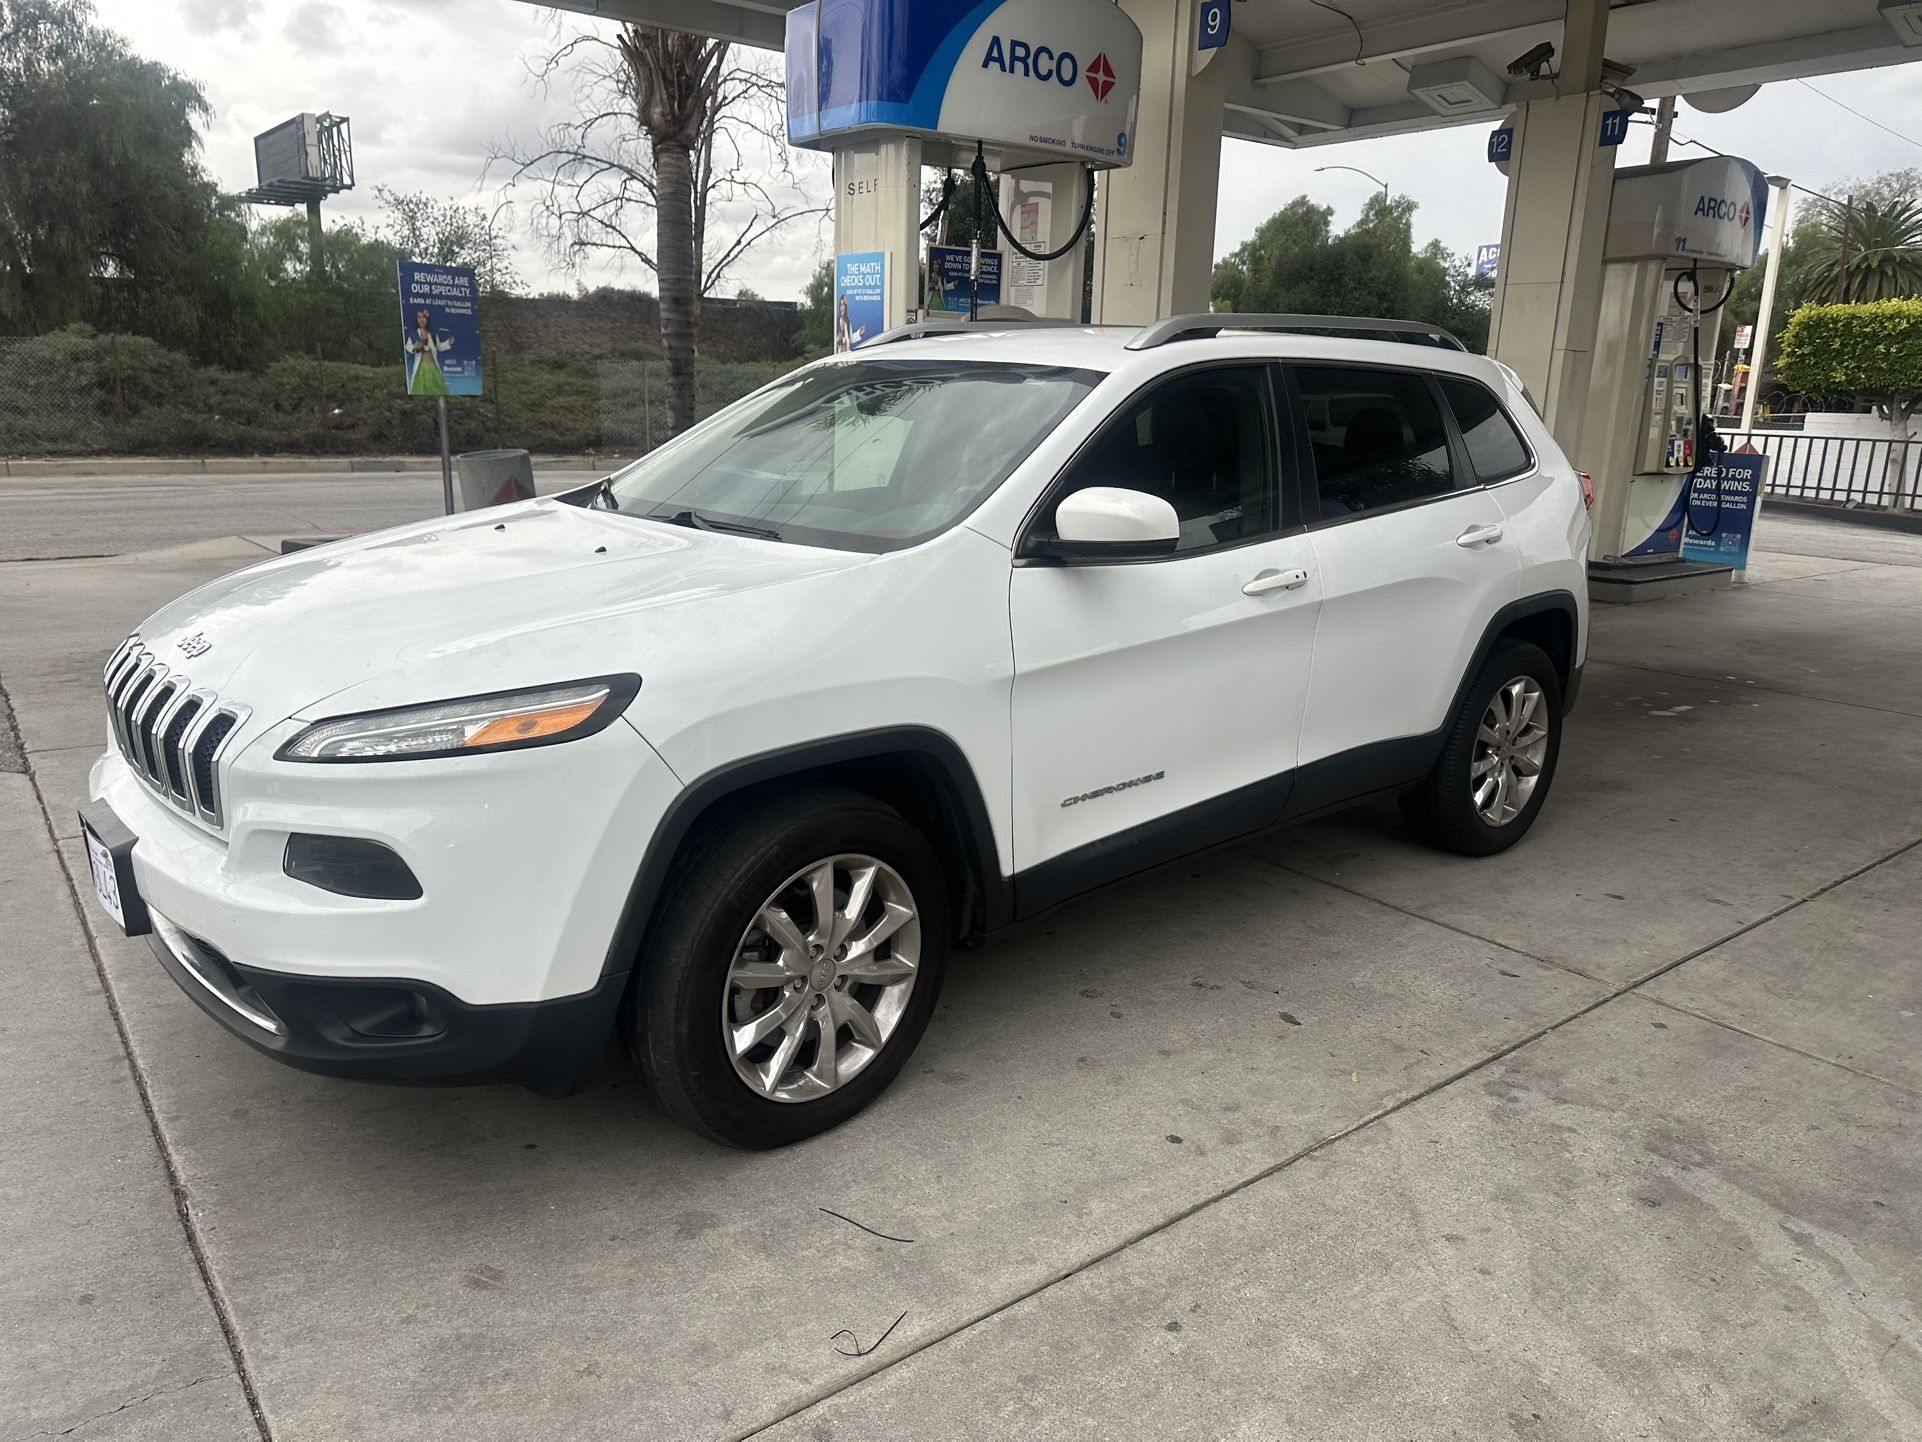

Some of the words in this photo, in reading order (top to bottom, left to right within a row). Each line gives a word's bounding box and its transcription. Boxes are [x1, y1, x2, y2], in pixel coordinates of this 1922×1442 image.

[1207, 7, 1220, 35] 9
[981, 35, 1078, 87] ARCO
[1605, 115, 1620, 136] 11
[1029, 134, 1039, 142] NO
[1038, 136, 1066, 147] SMOKING
[1116, 131, 1128, 156] 9
[1491, 134, 1508, 152] 12
[1694, 195, 1737, 222] ARCO
[1674, 235, 1688, 252] 11
[945, 254, 963, 263] WE'VE
[847, 263, 859, 275] THE
[860, 262, 881, 274] MATH
[944, 262, 962, 270] DOWN
[979, 264, 999, 273] CIENCE.
[414, 271, 453, 285] REWARDS
[454, 276, 470, 287] ARE
[841, 274, 864, 287] CHECKS
[864, 274, 882, 286] OUT.
[411, 283, 430, 294] OUR
[431, 285, 472, 297] SPECIALTY.
[1728, 468, 1753, 480] FOR
[1720, 480, 1753, 492] WINS.
[1701, 500, 1718, 508] EVER
[1721, 502, 1748, 510] GALLON.
[177, 631, 213, 660] Jeep
[1060, 770, 1165, 808] CHEROKEE
